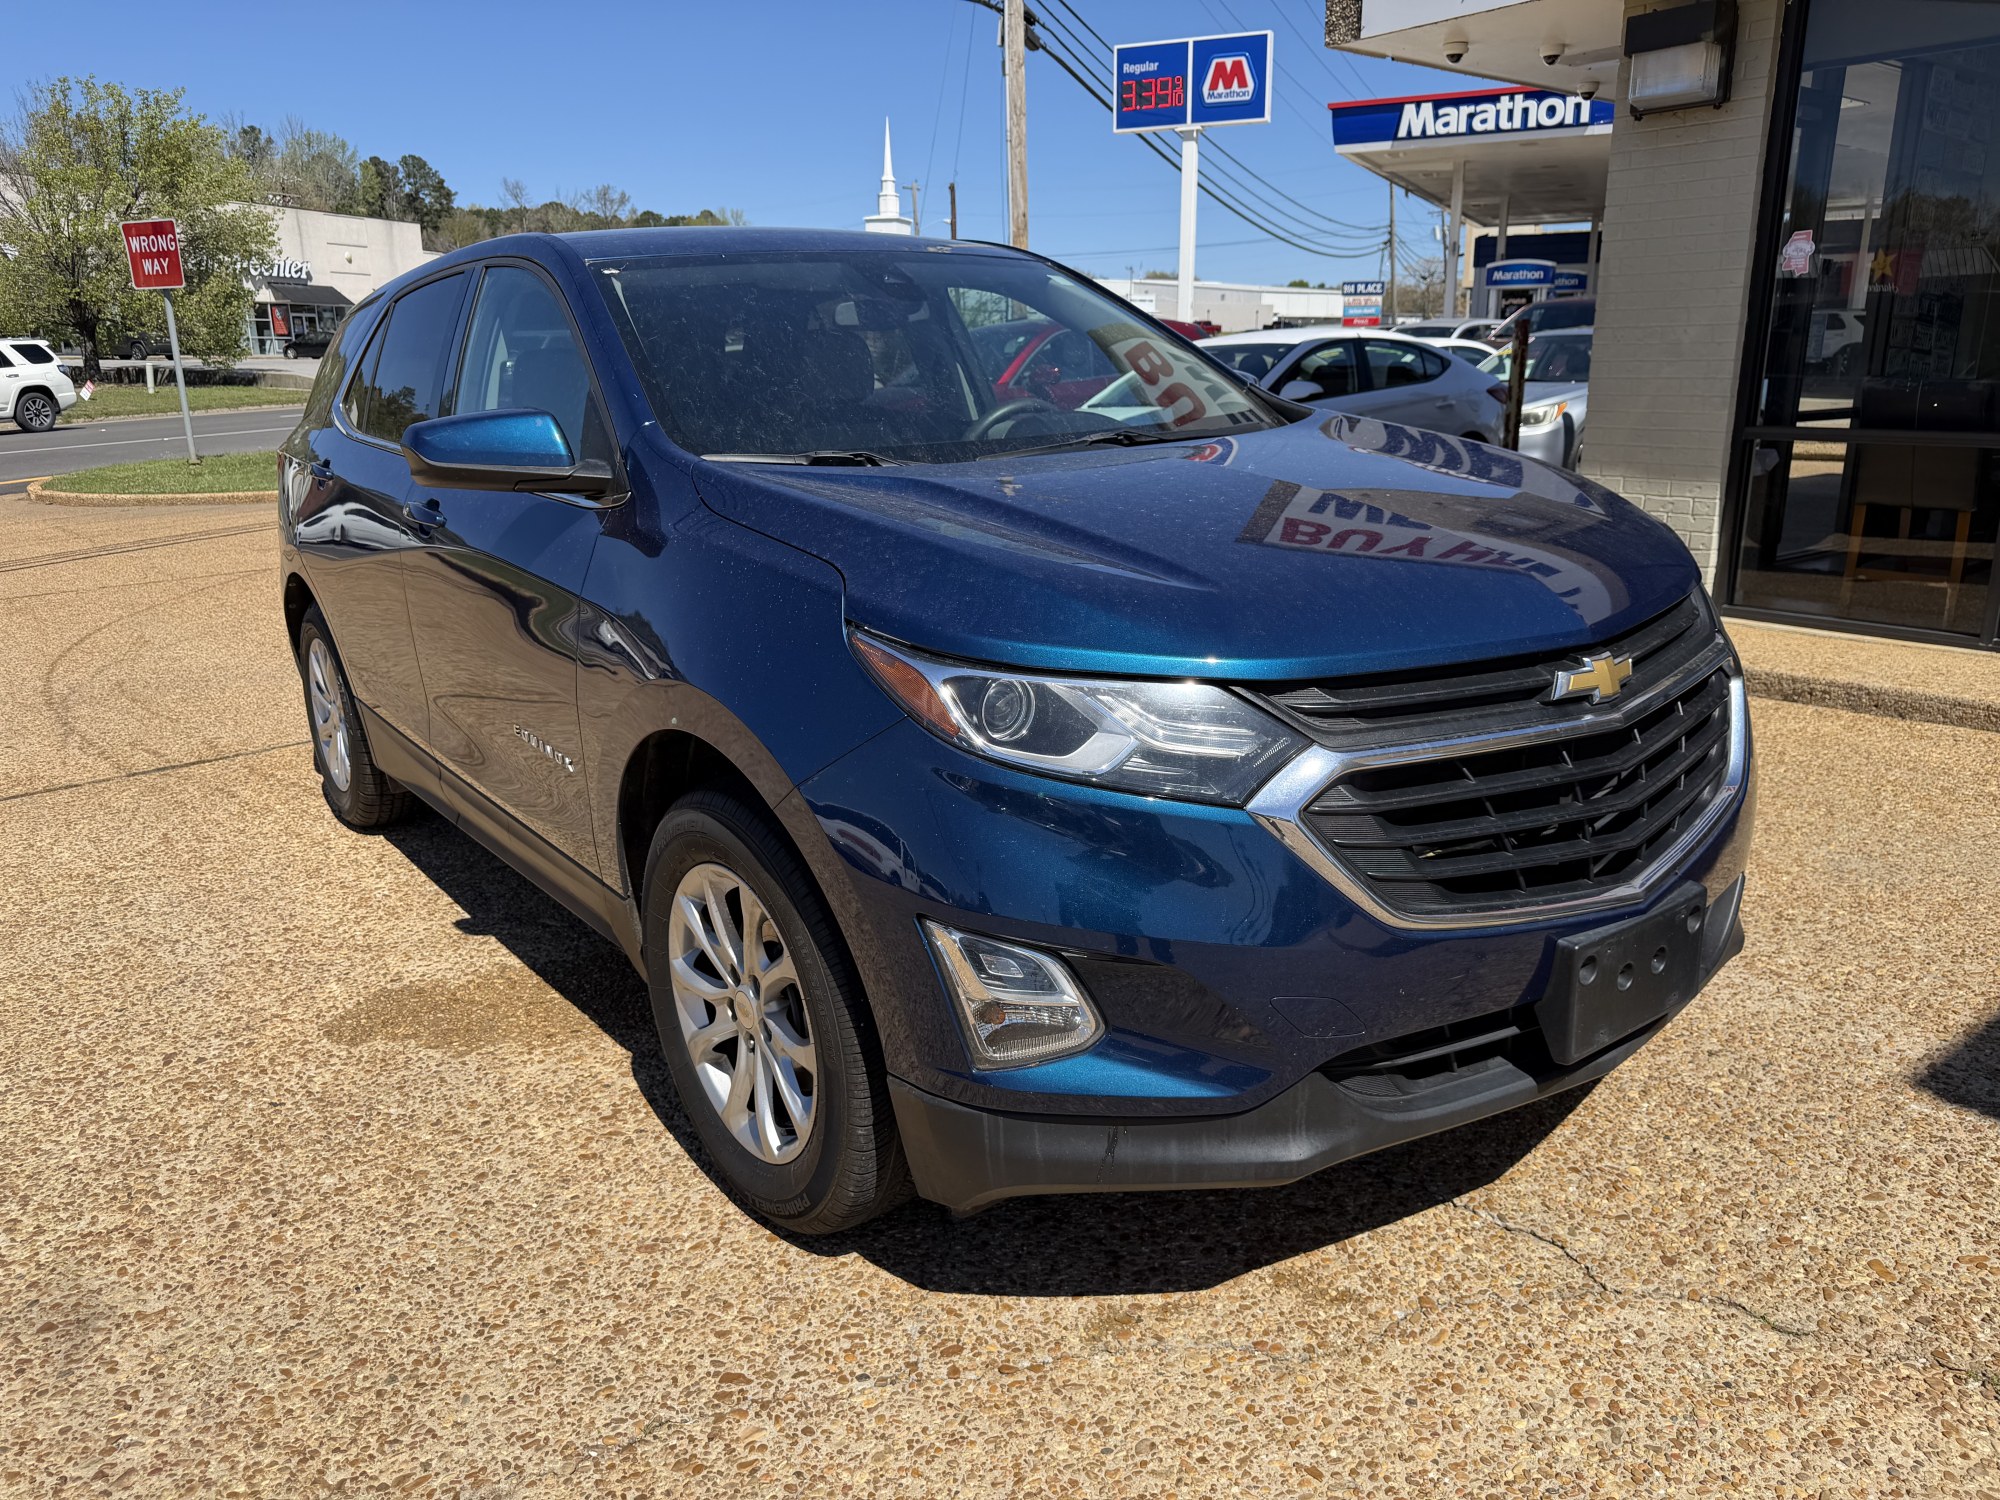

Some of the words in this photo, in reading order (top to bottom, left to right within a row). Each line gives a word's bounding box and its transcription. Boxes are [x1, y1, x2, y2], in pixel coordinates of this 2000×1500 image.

[1123, 61, 1159, 74] Regular
[1206, 90, 1250, 100] Marathon
[1397, 94, 1592, 138] Marathon
[128, 233, 176, 253] WRONG
[141, 257, 169, 276] WAY
[1492, 269, 1544, 281] Marathon
[1554, 277, 1579, 286] athon
[744, 1191, 812, 1216] PRIMEWELL
